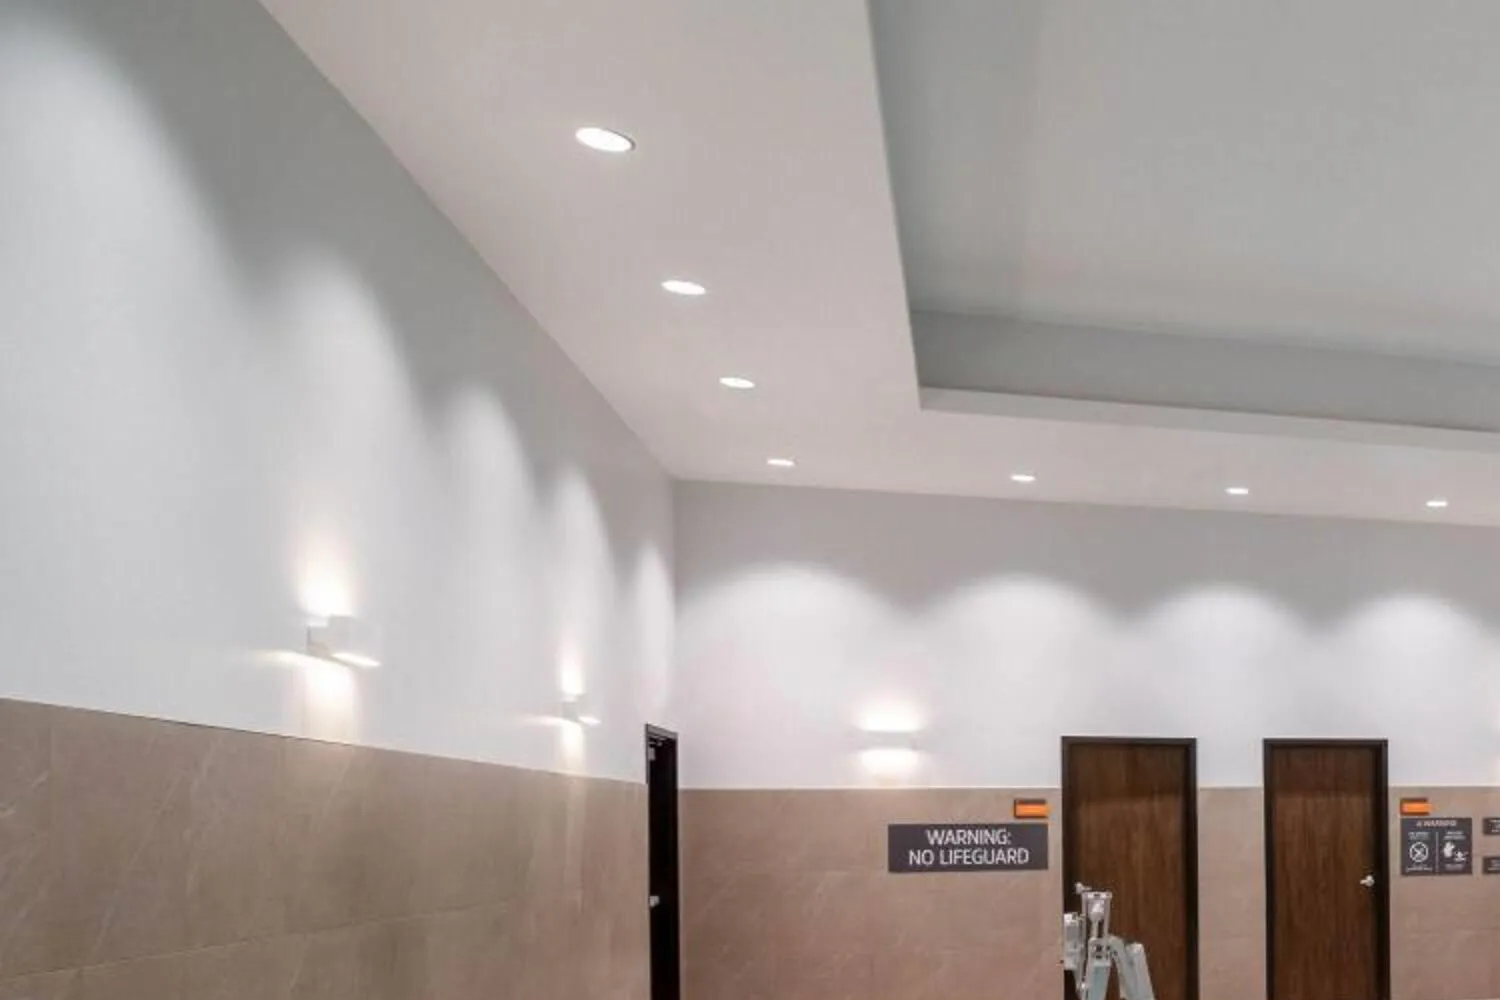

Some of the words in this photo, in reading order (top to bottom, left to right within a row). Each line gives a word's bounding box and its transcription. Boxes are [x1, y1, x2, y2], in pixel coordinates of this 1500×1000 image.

[926, 829, 1012, 846] WARNING:
[908, 849, 935, 866] NO
[939, 847, 1030, 865] LIFEGUARD
